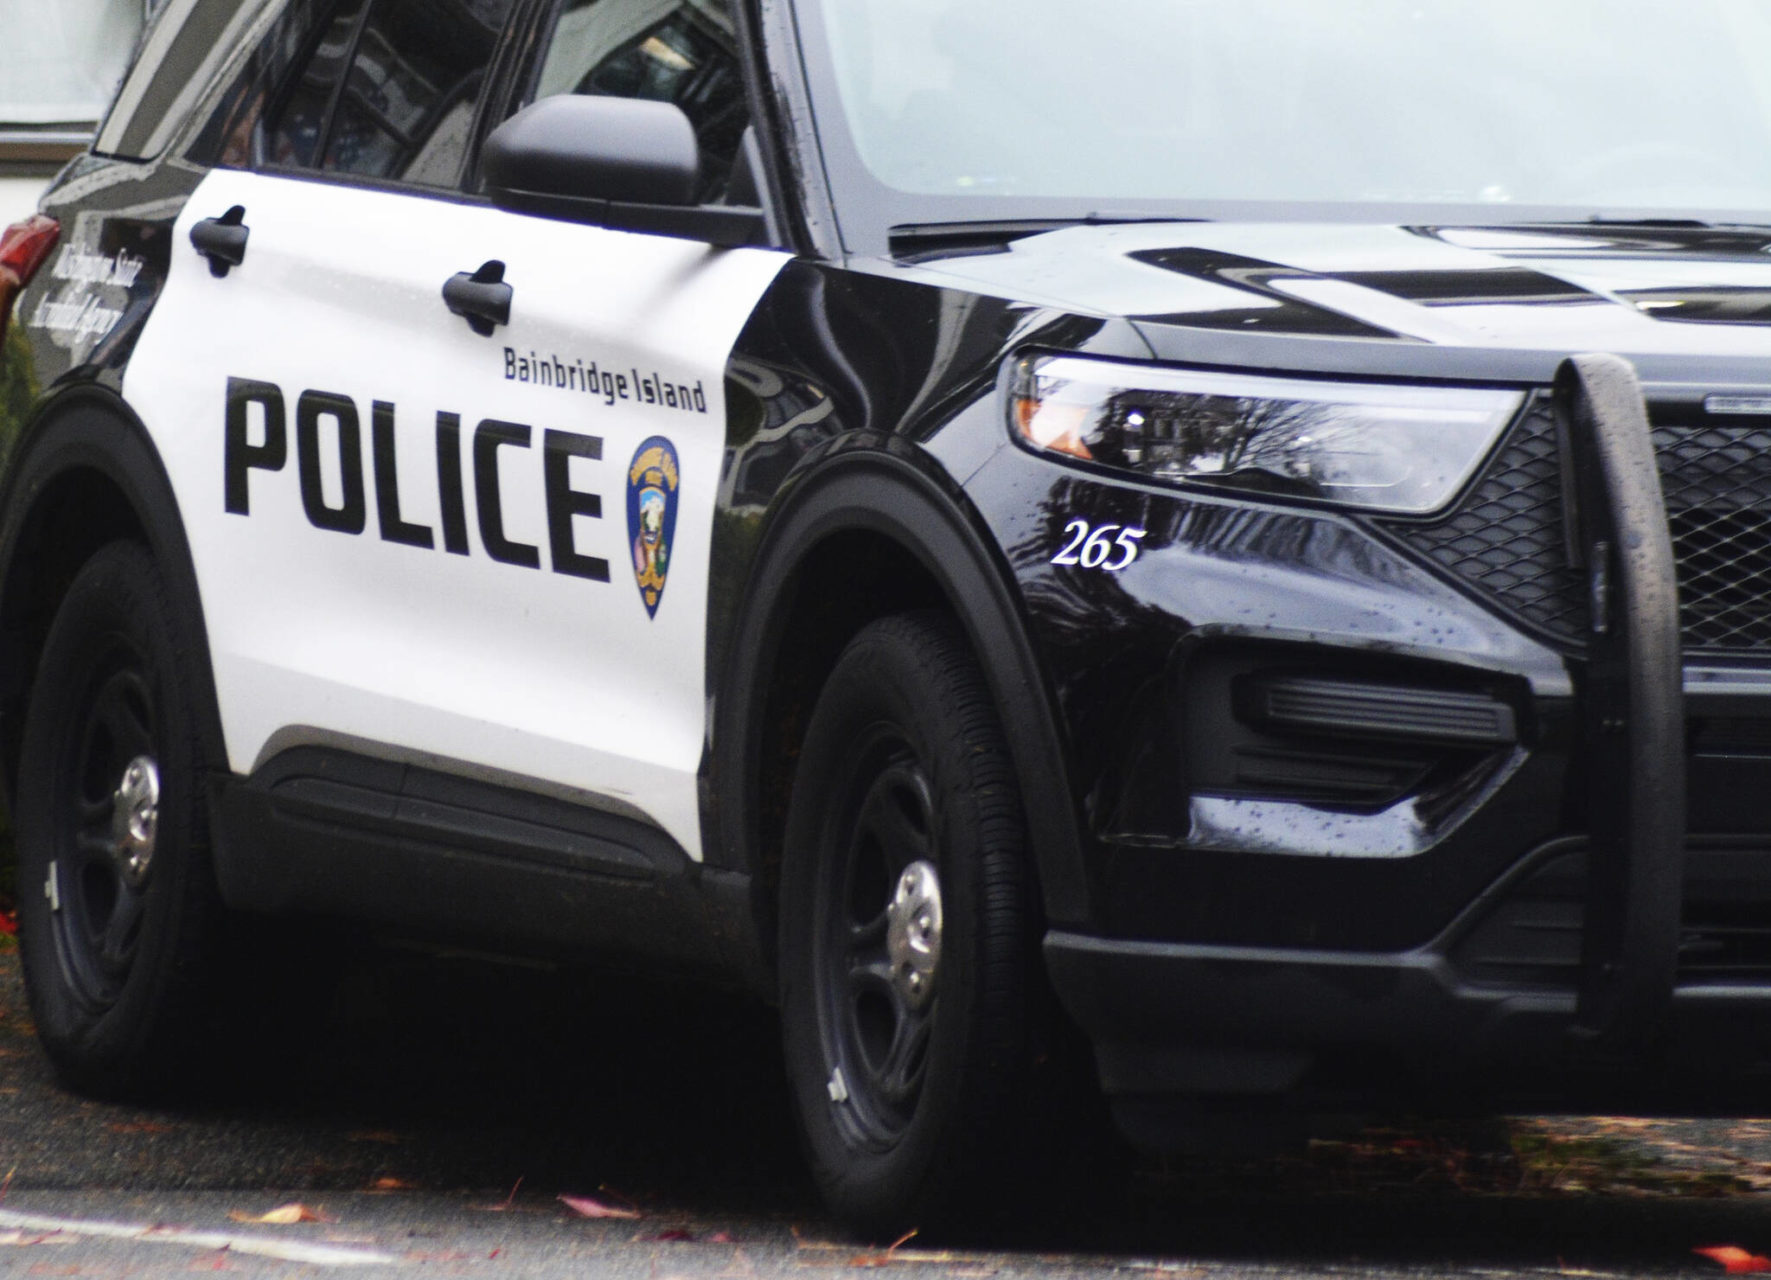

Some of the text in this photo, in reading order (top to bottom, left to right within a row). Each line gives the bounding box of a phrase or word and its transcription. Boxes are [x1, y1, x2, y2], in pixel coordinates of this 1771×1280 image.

[503, 346, 707, 414] Bainbridge Island
[224, 377, 611, 583] POLICE
[1050, 520, 1148, 571] 265
